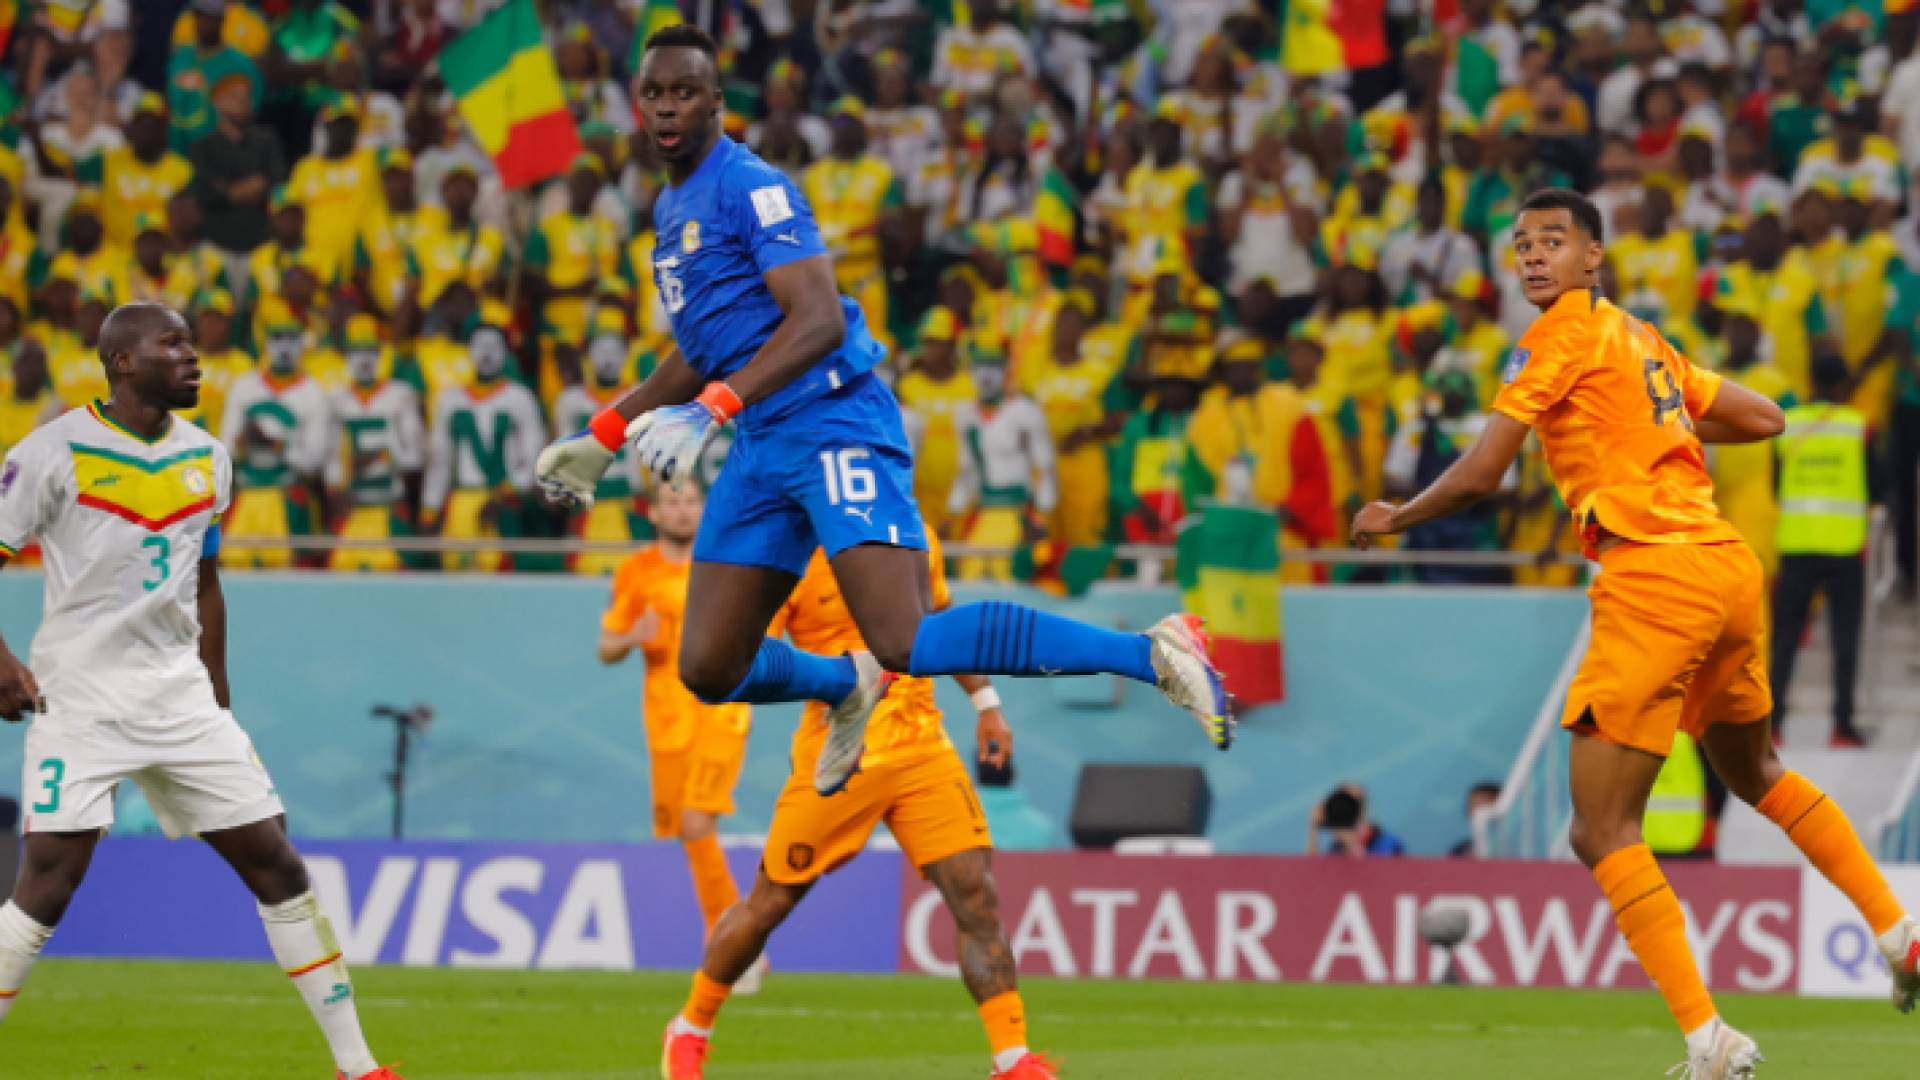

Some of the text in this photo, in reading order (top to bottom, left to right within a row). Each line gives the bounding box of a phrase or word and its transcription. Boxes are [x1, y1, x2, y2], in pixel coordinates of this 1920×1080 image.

[820, 448, 876, 506] 16
[142, 534, 171, 591] 3
[33, 758, 64, 813] 3
[303, 856, 636, 970] VISA
